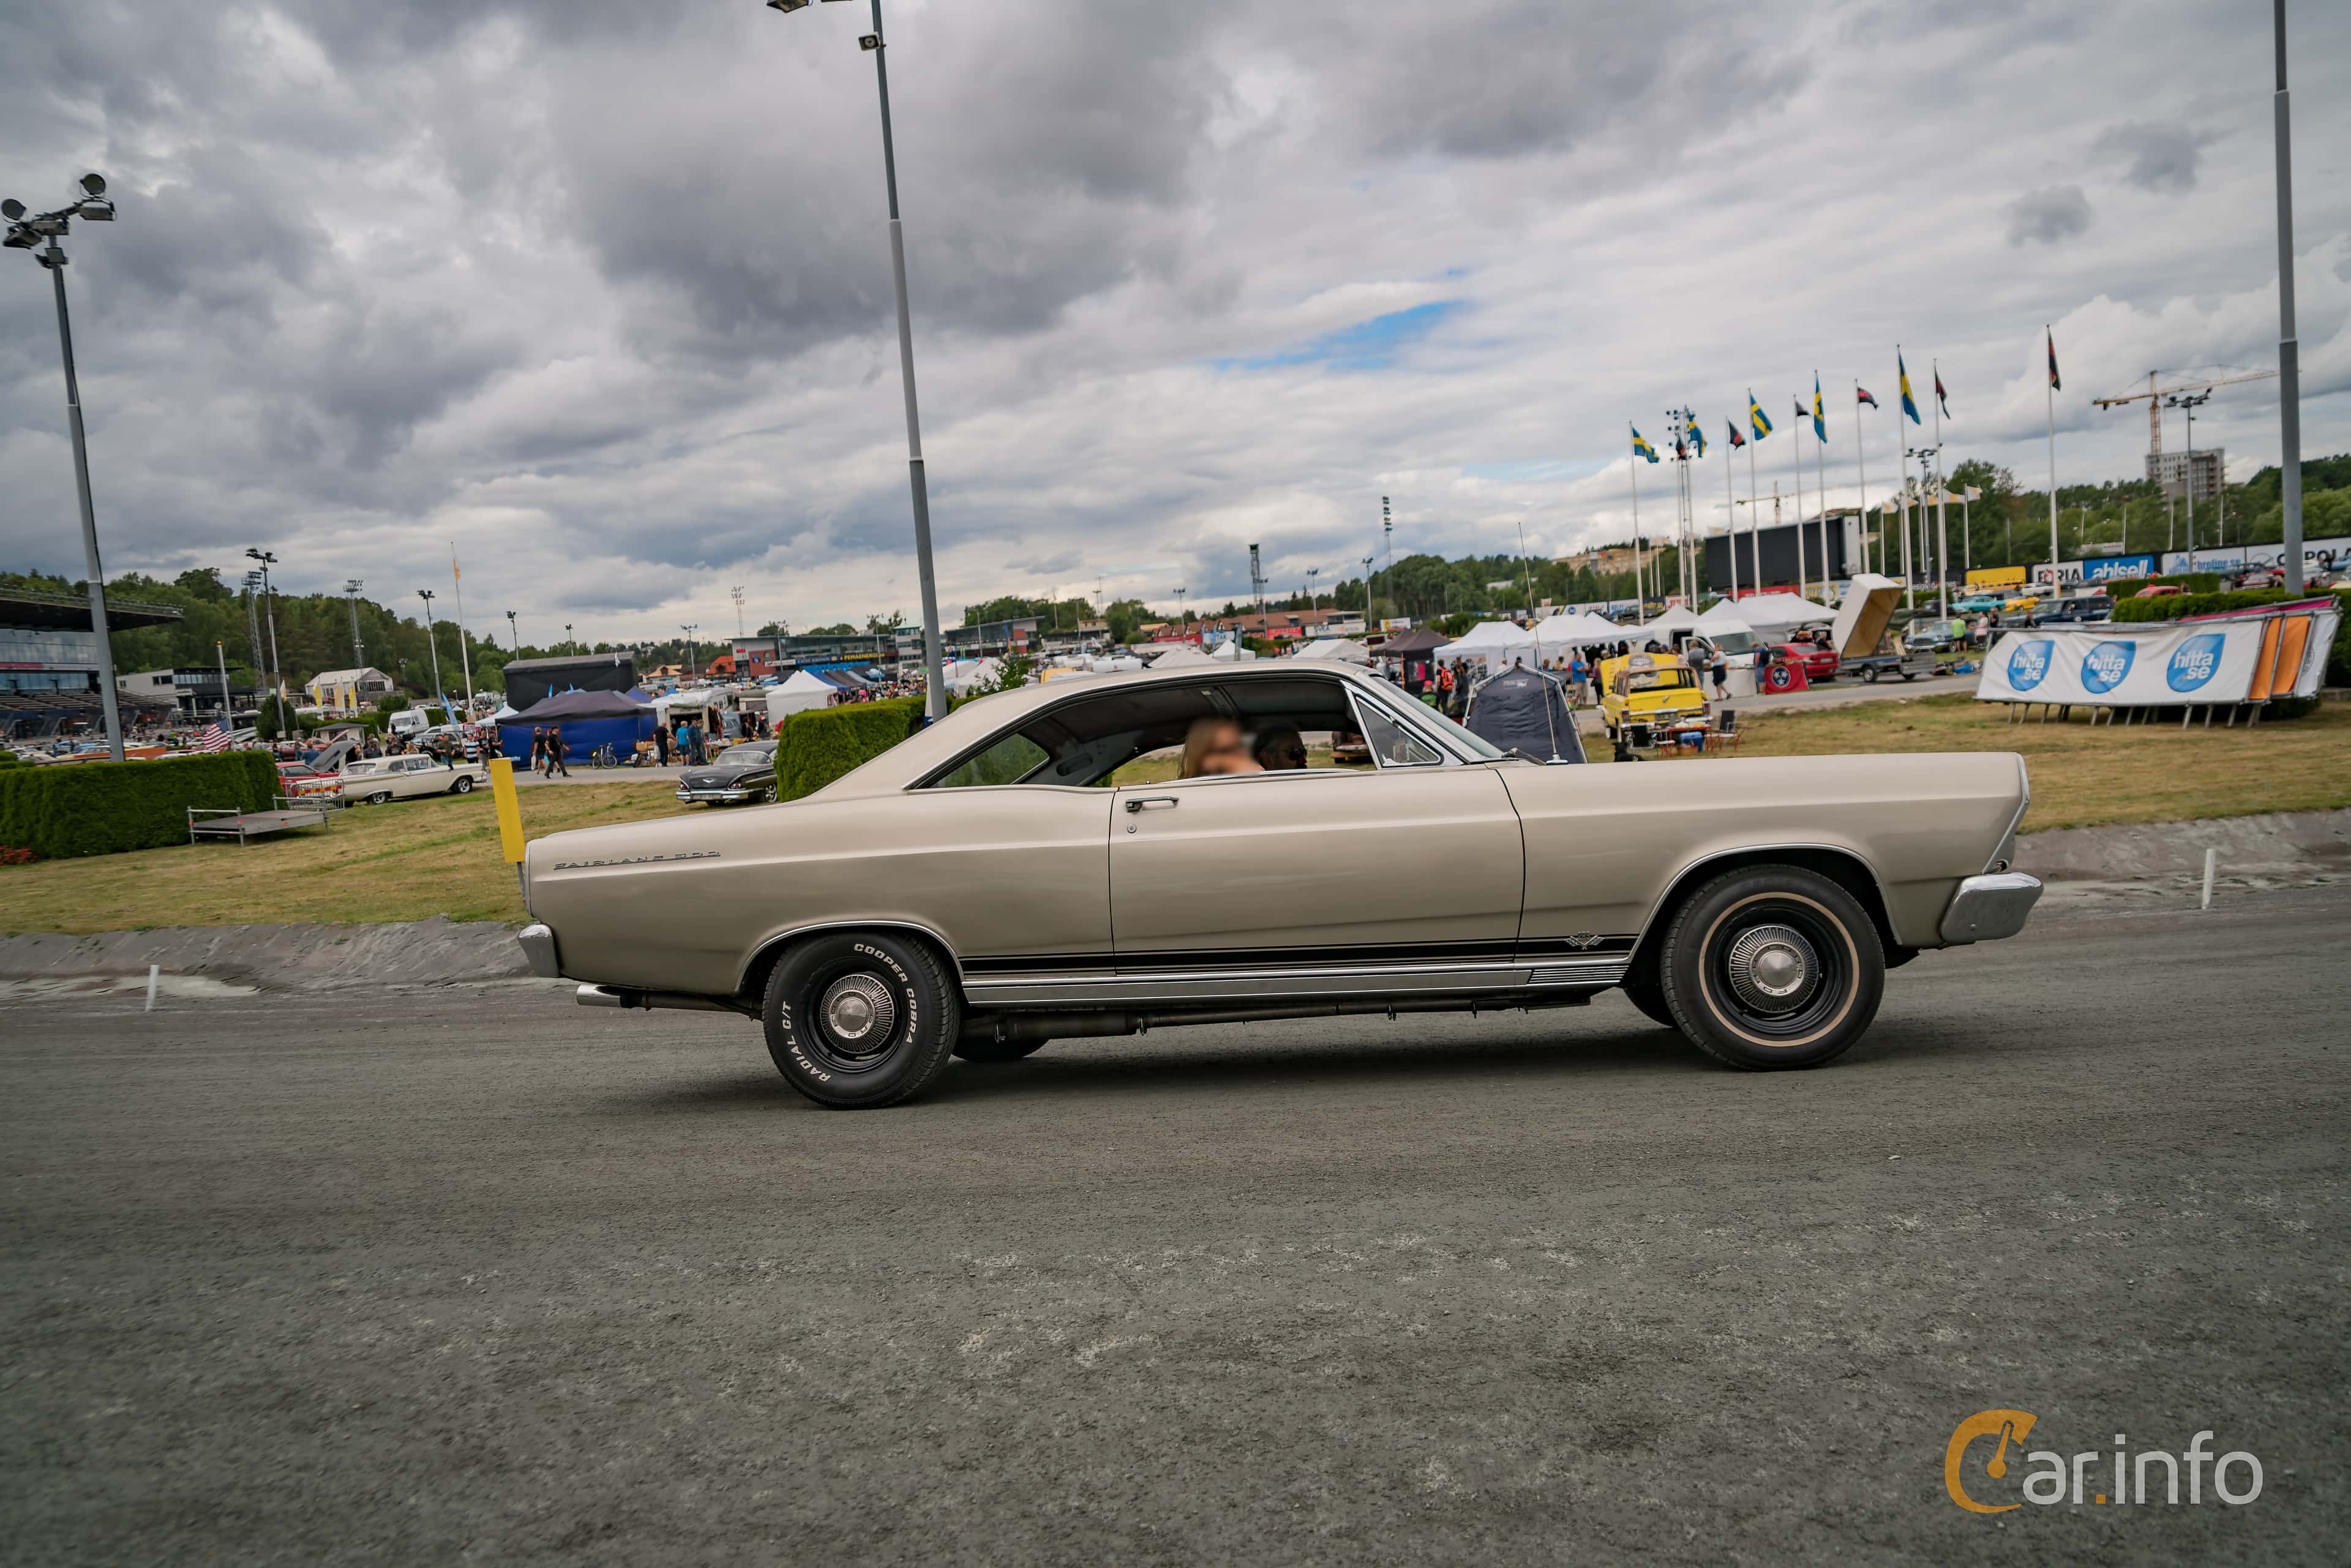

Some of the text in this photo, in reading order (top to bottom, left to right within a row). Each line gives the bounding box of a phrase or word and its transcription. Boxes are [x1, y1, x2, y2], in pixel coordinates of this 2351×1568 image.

[2038, 568, 2082, 582] FORIA
[2093, 560, 2148, 580] ahlsell
[2013, 653, 2045, 669] hitta
[2087, 654, 2126, 670] hitta
[2174, 650, 2214, 669] hitta
[553, 850, 721, 870] FAIRLANE 500
[854, 943, 918, 1043] COOPER COBRA
[782, 1001, 832, 1082] RADIAL G/T
